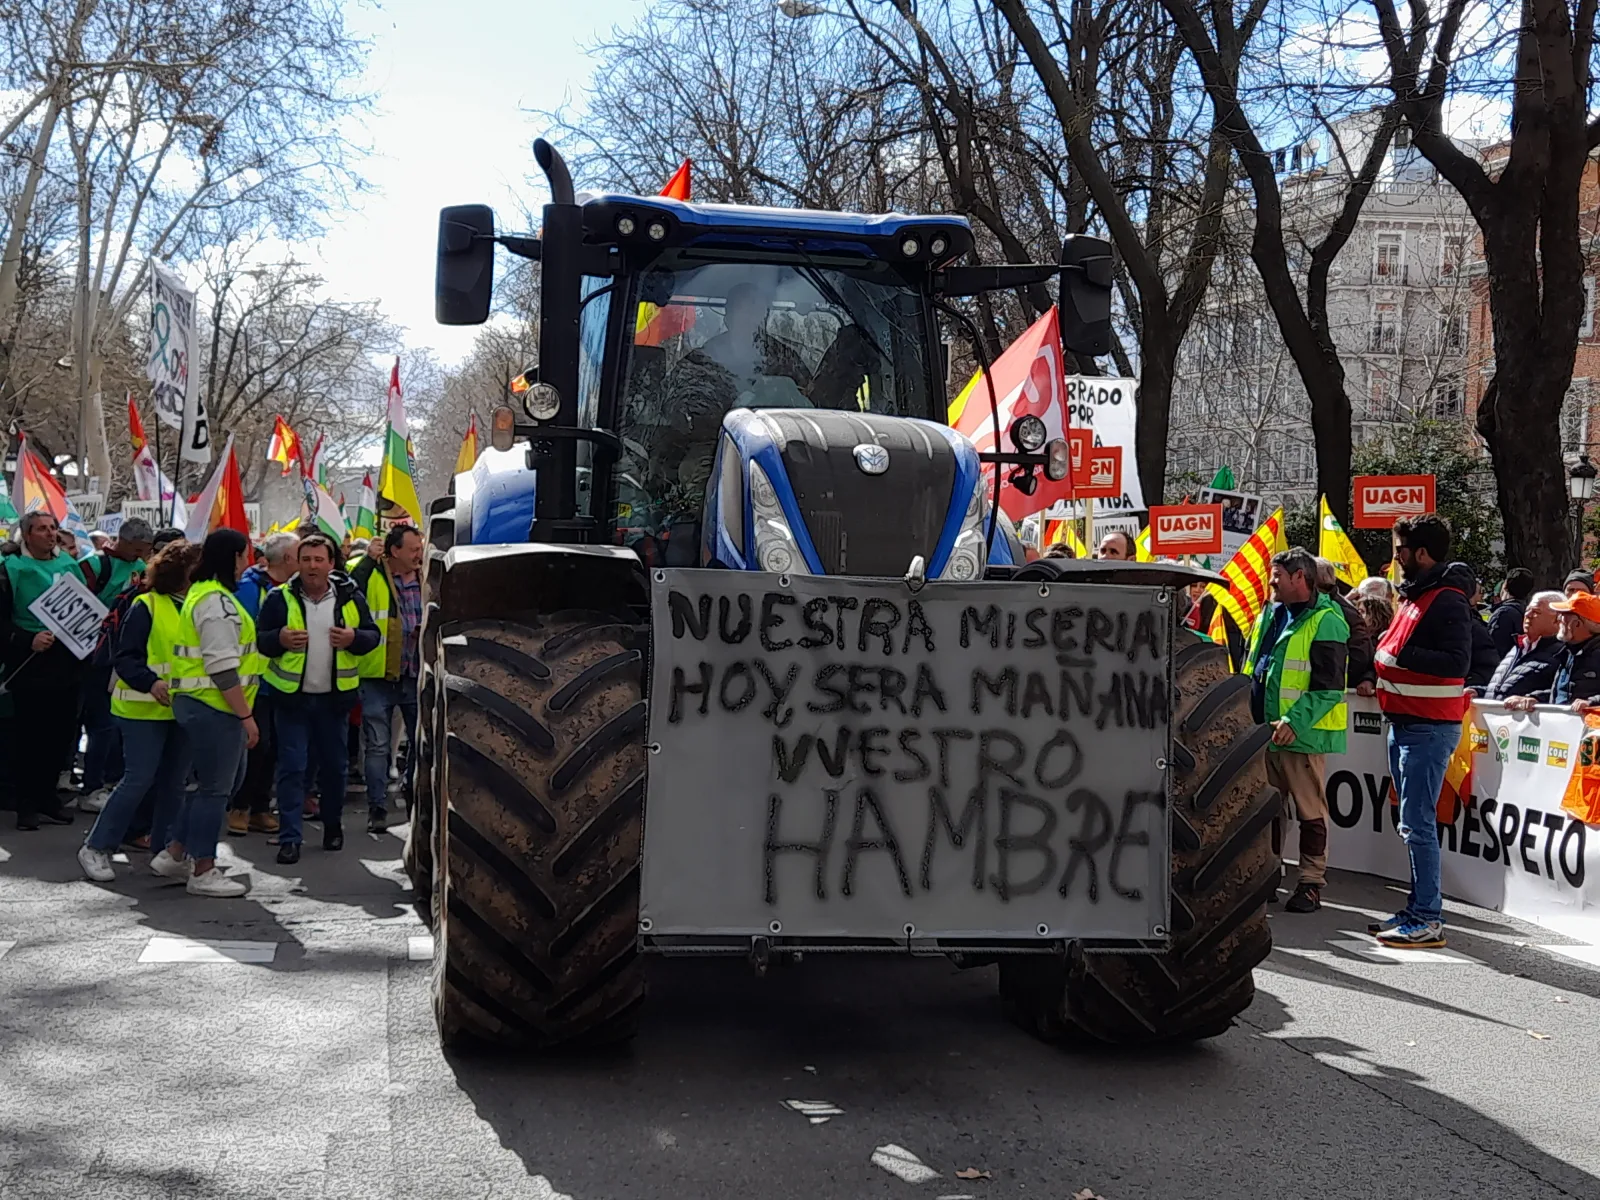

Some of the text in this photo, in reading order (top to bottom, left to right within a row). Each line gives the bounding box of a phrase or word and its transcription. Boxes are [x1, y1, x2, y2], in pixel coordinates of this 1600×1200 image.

[1067, 380, 1122, 405] RRADO
[1069, 404, 1094, 425] POR
[1091, 460, 1112, 475] GN
[1365, 486, 1424, 505] UAGN
[1160, 516, 1212, 531] UAGN
[668, 590, 1160, 661] NUESTRA MISERIA
[667, 658, 801, 728] HOY
[806, 662, 947, 718] SERA
[1495, 751, 1508, 764] UPA
[763, 786, 1168, 904] HAMBRE
